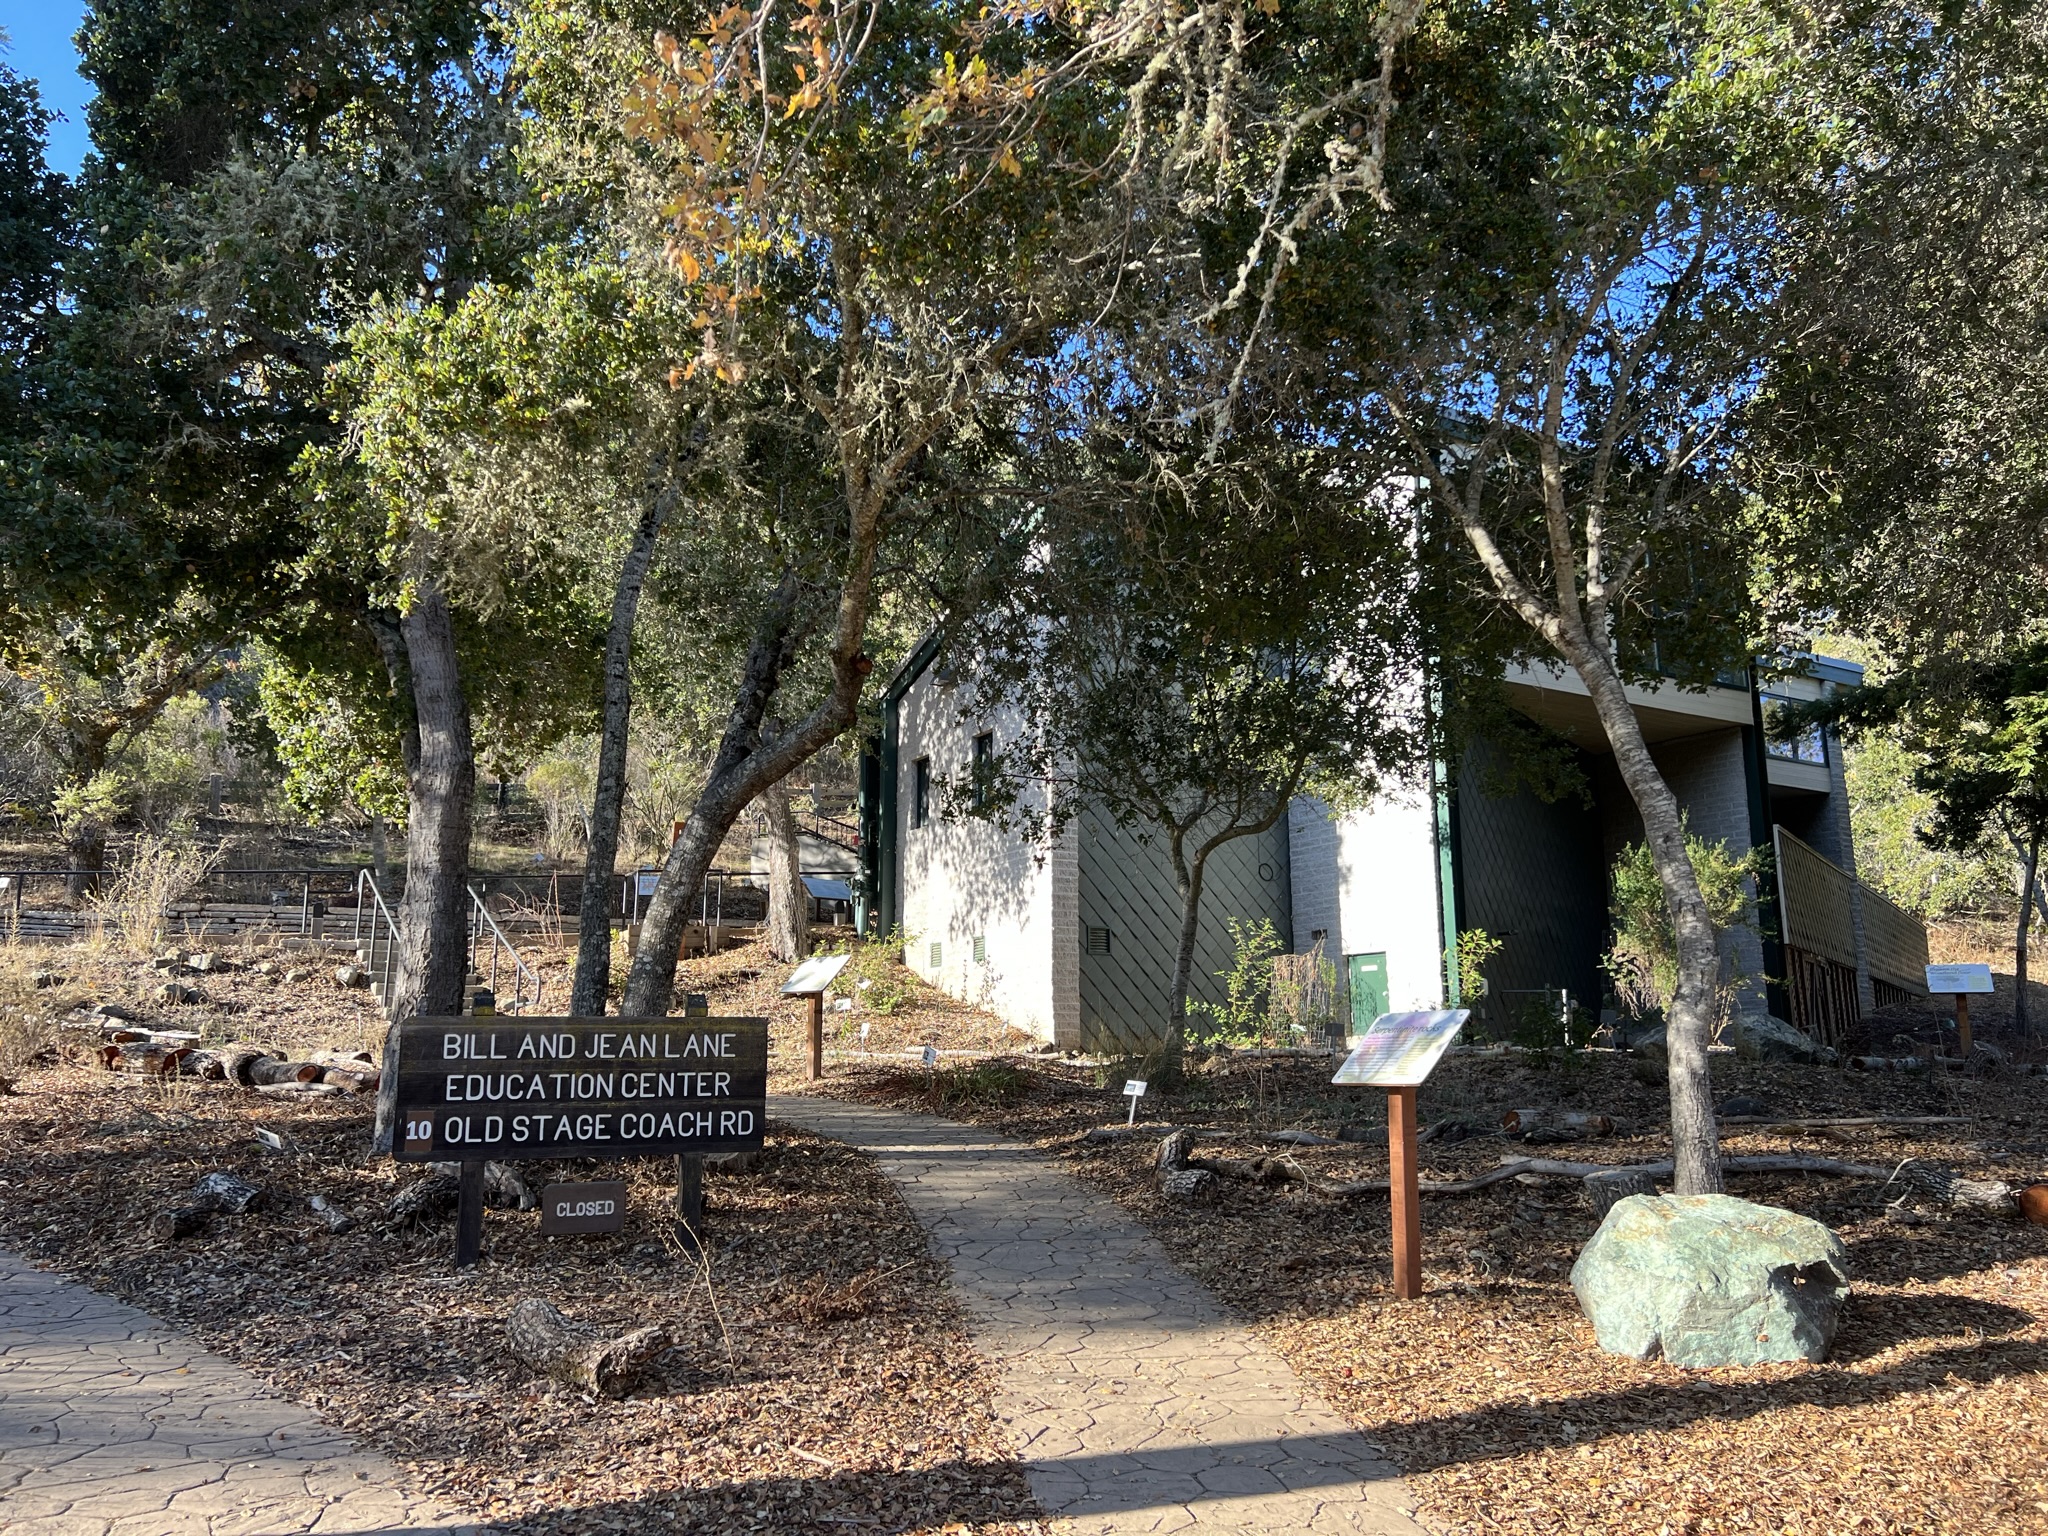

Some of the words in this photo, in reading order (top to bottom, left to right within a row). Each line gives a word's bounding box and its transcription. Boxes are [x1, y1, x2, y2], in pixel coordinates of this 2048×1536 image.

[443, 1034, 507, 1060] BILL
[517, 1033, 575, 1059] AND
[585, 1033, 657, 1059] JEAN
[664, 1033, 736, 1058] LANE
[446, 1073, 613, 1101] EDUCATION
[621, 1072, 731, 1098] CENTER
[406, 1120, 432, 1140] 10
[444, 1116, 504, 1143] OLD
[512, 1114, 612, 1142] STAGE
[620, 1111, 713, 1139] COACH
[720, 1110, 754, 1136] RD
[556, 1200, 615, 1217] CLOSED
